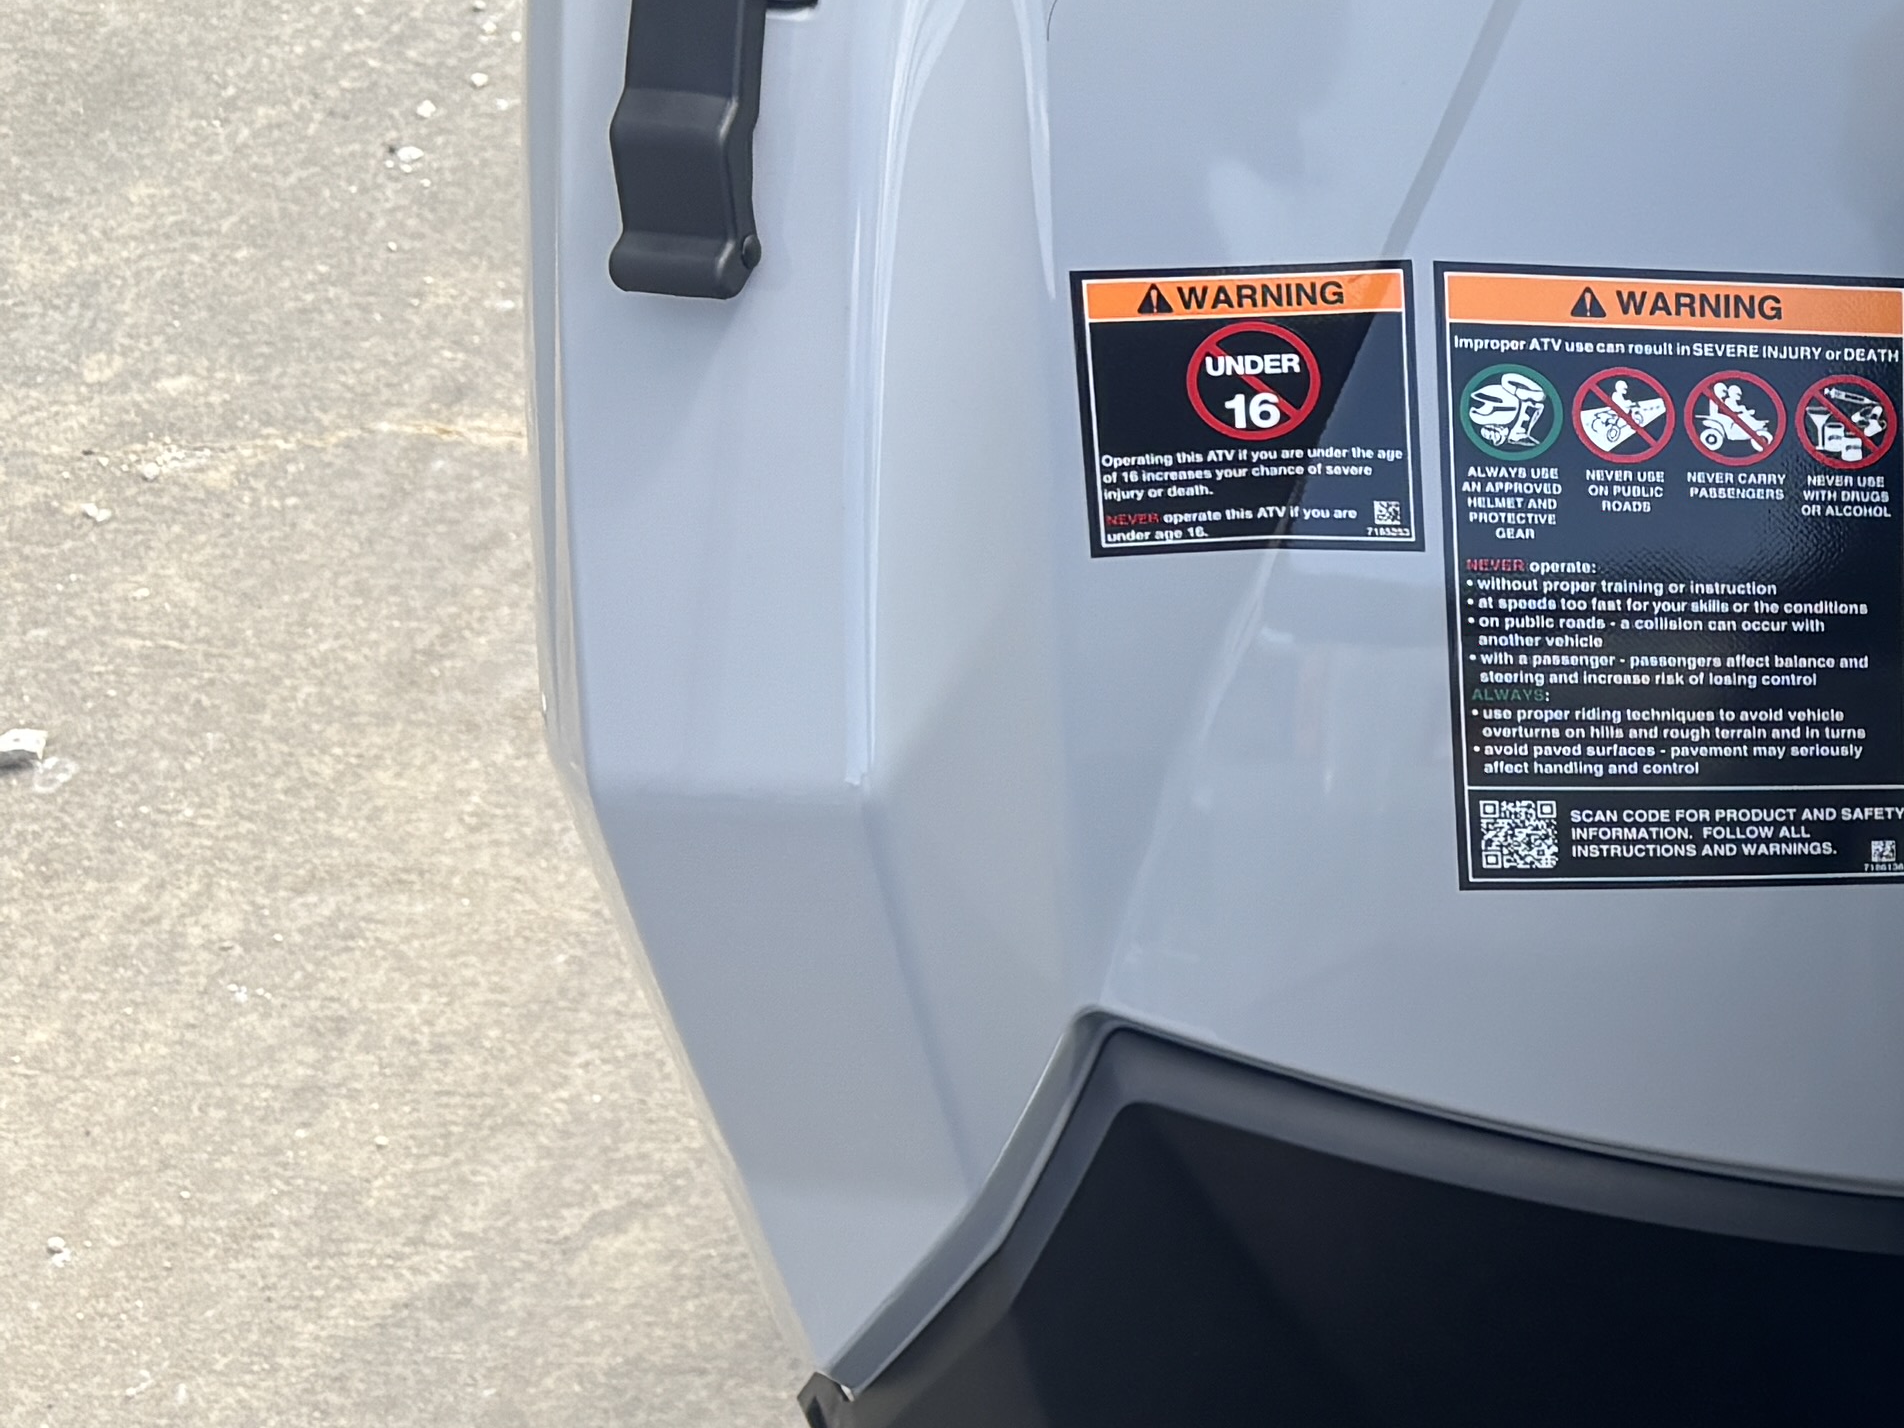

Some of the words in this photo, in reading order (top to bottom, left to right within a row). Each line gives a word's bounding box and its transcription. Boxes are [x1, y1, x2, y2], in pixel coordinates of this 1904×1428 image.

[1177, 280, 1344, 310] WARNING
[1615, 290, 1783, 321] WARNING
[1454, 334, 1526, 353] Improper
[1529, 337, 1562, 352] ATV
[1564, 341, 1594, 353] use
[1596, 342, 1625, 354] can
[1628, 342, 1673, 356] result
[1676, 342, 1691, 356] in
[1692, 342, 1759, 358] SEVERE
[1762, 345, 1822, 360] INJURY
[1825, 349, 1842, 361] or
[1843, 347, 1899, 363] DEATH
[1205, 353, 1301, 377] UNDER
[1224, 392, 1281, 429] 16
[1101, 453, 1173, 469] Operating
[1176, 451, 1204, 464] this
[1207, 449, 1235, 462] ATV
[1238, 448, 1248, 461] if
[1250, 450, 1278, 463] you
[1281, 448, 1304, 459] are
[1307, 446, 1350, 459] under
[1351, 446, 1374, 459] the
[1377, 449, 1403, 462] age
[1102, 471, 1118, 484] of
[1121, 470, 1139, 483] 16
[1142, 469, 1212, 482] increases
[1215, 468, 1248, 481] your
[1251, 464, 1305, 477] chance
[1307, 463, 1323, 475] of
[1325, 465, 1373, 476] severe
[1467, 466, 1527, 479] ALWAYS
[1530, 467, 1559, 480] USE
[1586, 469, 1633, 482] NEVER
[1637, 471, 1665, 483] USE
[1686, 471, 1734, 484] NEVER
[1737, 473, 1786, 485] CARRY
[1461, 481, 1481, 493] AN
[1485, 481, 1562, 495] APPROVED
[1807, 474, 1853, 487] NEVER
[1857, 475, 1885, 488] USE
[1103, 487, 1145, 502] injury
[1147, 488, 1164, 498] or
[1167, 484, 1214, 498] death.
[1588, 484, 1609, 496] ON
[1613, 484, 1663, 498] PUBLIC
[1689, 486, 1785, 500] PASSENGERS
[1802, 489, 1837, 502] WITH
[1841, 490, 1889, 503] DRUGS
[1467, 496, 1524, 509] HELMET
[1527, 498, 1557, 510] AND
[1601, 500, 1651, 513] ROADS
[1106, 513, 1160, 526] NEVER
[1163, 510, 1222, 525] operate
[1225, 508, 1253, 520] this
[1257, 506, 1286, 519] ATV
[1289, 505, 1300, 518] if
[1302, 508, 1331, 520] you
[1333, 509, 1358, 519] are
[1469, 511, 1556, 525] PROTECTIVE
[1800, 504, 1822, 517] OR
[1825, 504, 1891, 518] ALCOHOL
[1107, 529, 1151, 542] under
[1154, 529, 1186, 542] age
[1188, 525, 1209, 538] 16.
[1495, 527, 1535, 539] GEAR
[1570, 809, 1618, 823] SCAN
[1622, 809, 1671, 823] CODE
[1675, 809, 1710, 822] FOR
[1715, 808, 1796, 822] PRODUCT
[1801, 807, 1837, 821] AND
[1571, 826, 1693, 840] INFORMATION.
[1702, 825, 1774, 839] FOLLOW
[1779, 825, 1811, 838] ALL
[1572, 843, 1697, 858] INSTRUCTIONS
[1701, 843, 1737, 857] AND
[1741, 841, 1837, 856] WARNINGS.
